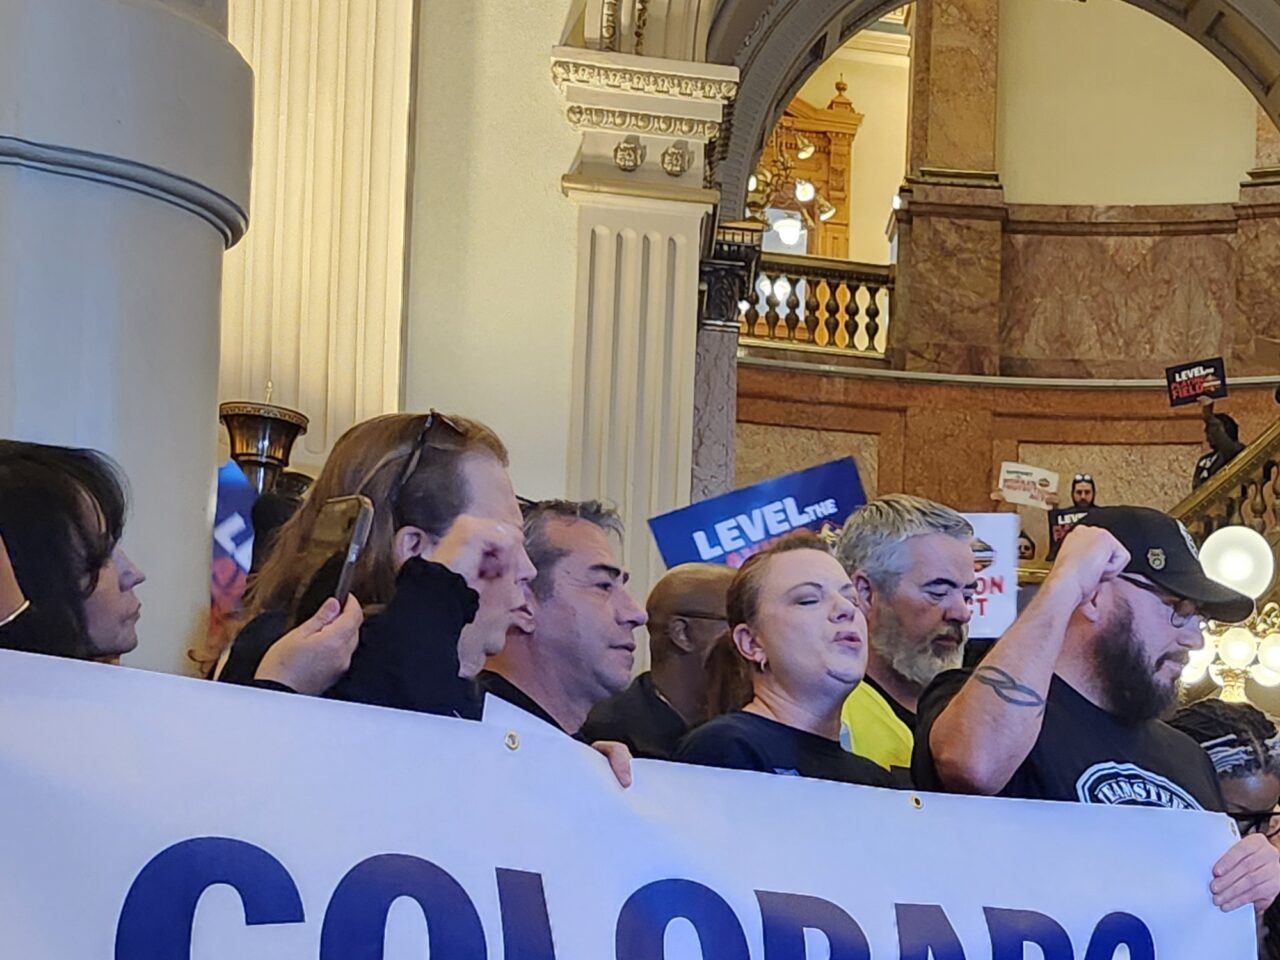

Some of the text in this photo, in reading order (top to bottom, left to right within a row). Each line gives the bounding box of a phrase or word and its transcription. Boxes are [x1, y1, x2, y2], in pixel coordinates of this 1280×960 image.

[1175, 366, 1207, 382] LEVEL
[693, 497, 811, 561] LEVEL
[805, 499, 838, 520] THE
